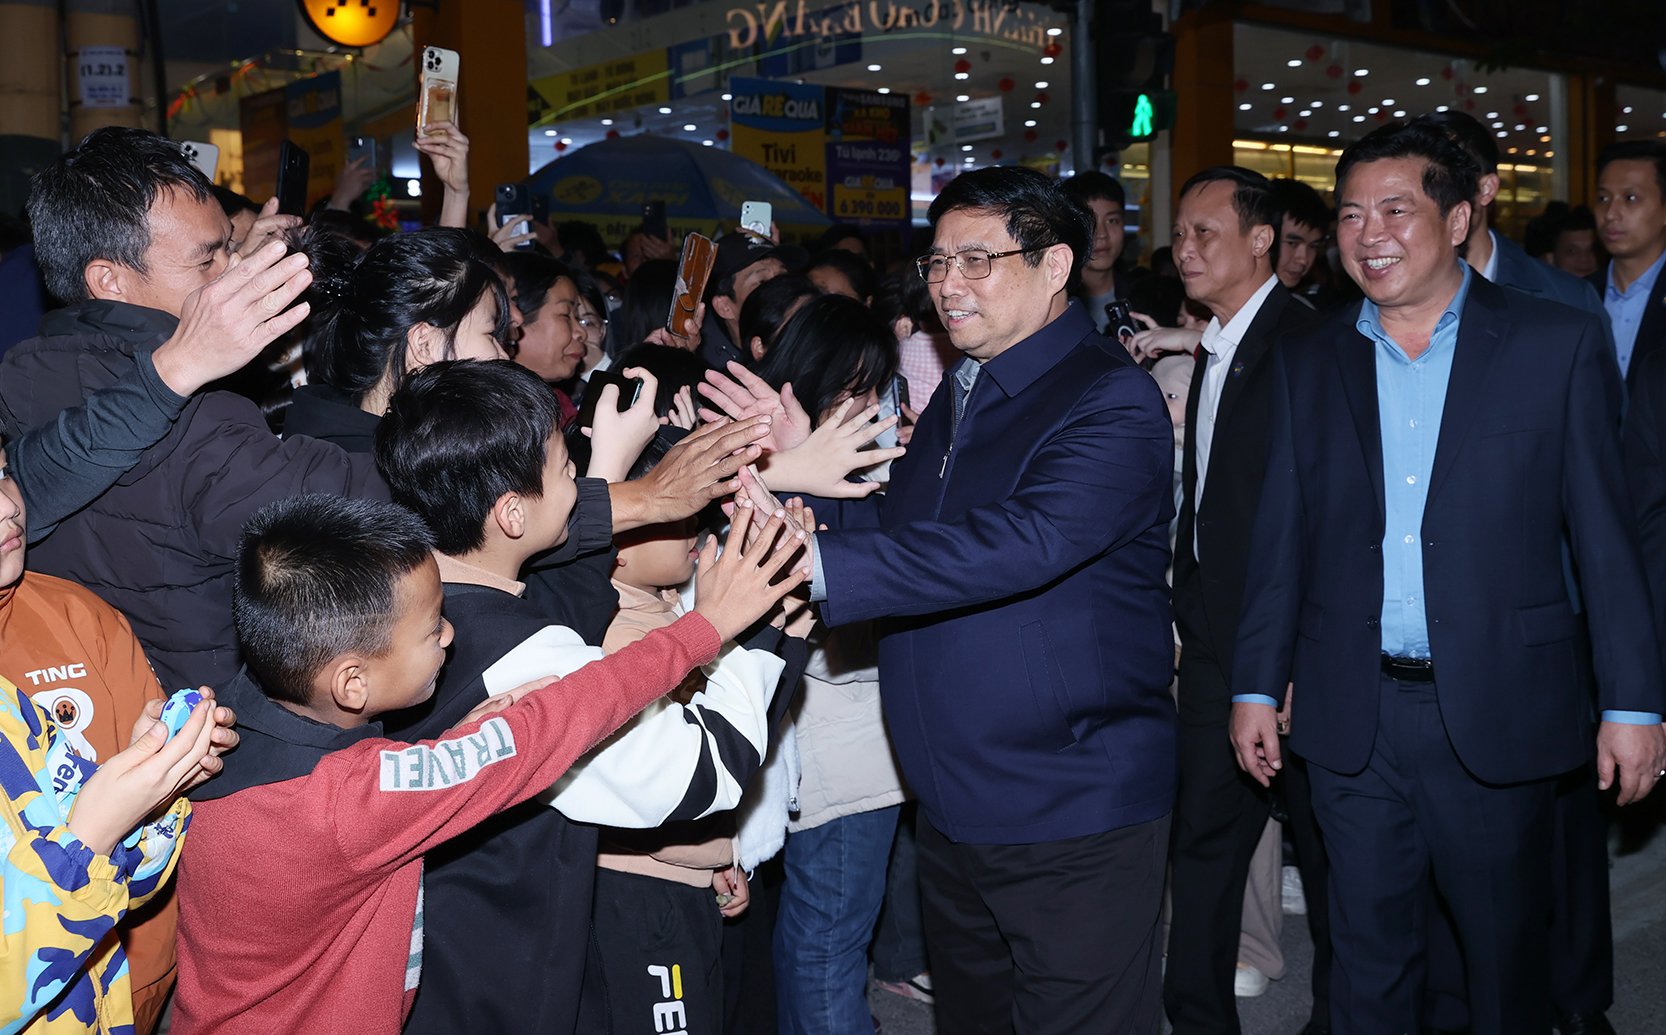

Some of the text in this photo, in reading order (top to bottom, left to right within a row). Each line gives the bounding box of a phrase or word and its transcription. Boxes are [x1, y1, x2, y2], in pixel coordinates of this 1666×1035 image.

[761, 143, 796, 165] Tivi
[766, 166, 822, 183] araoke
[25, 663, 87, 686] TING
[384, 720, 514, 788] TRAVEL
[647, 964, 688, 1035] FE
